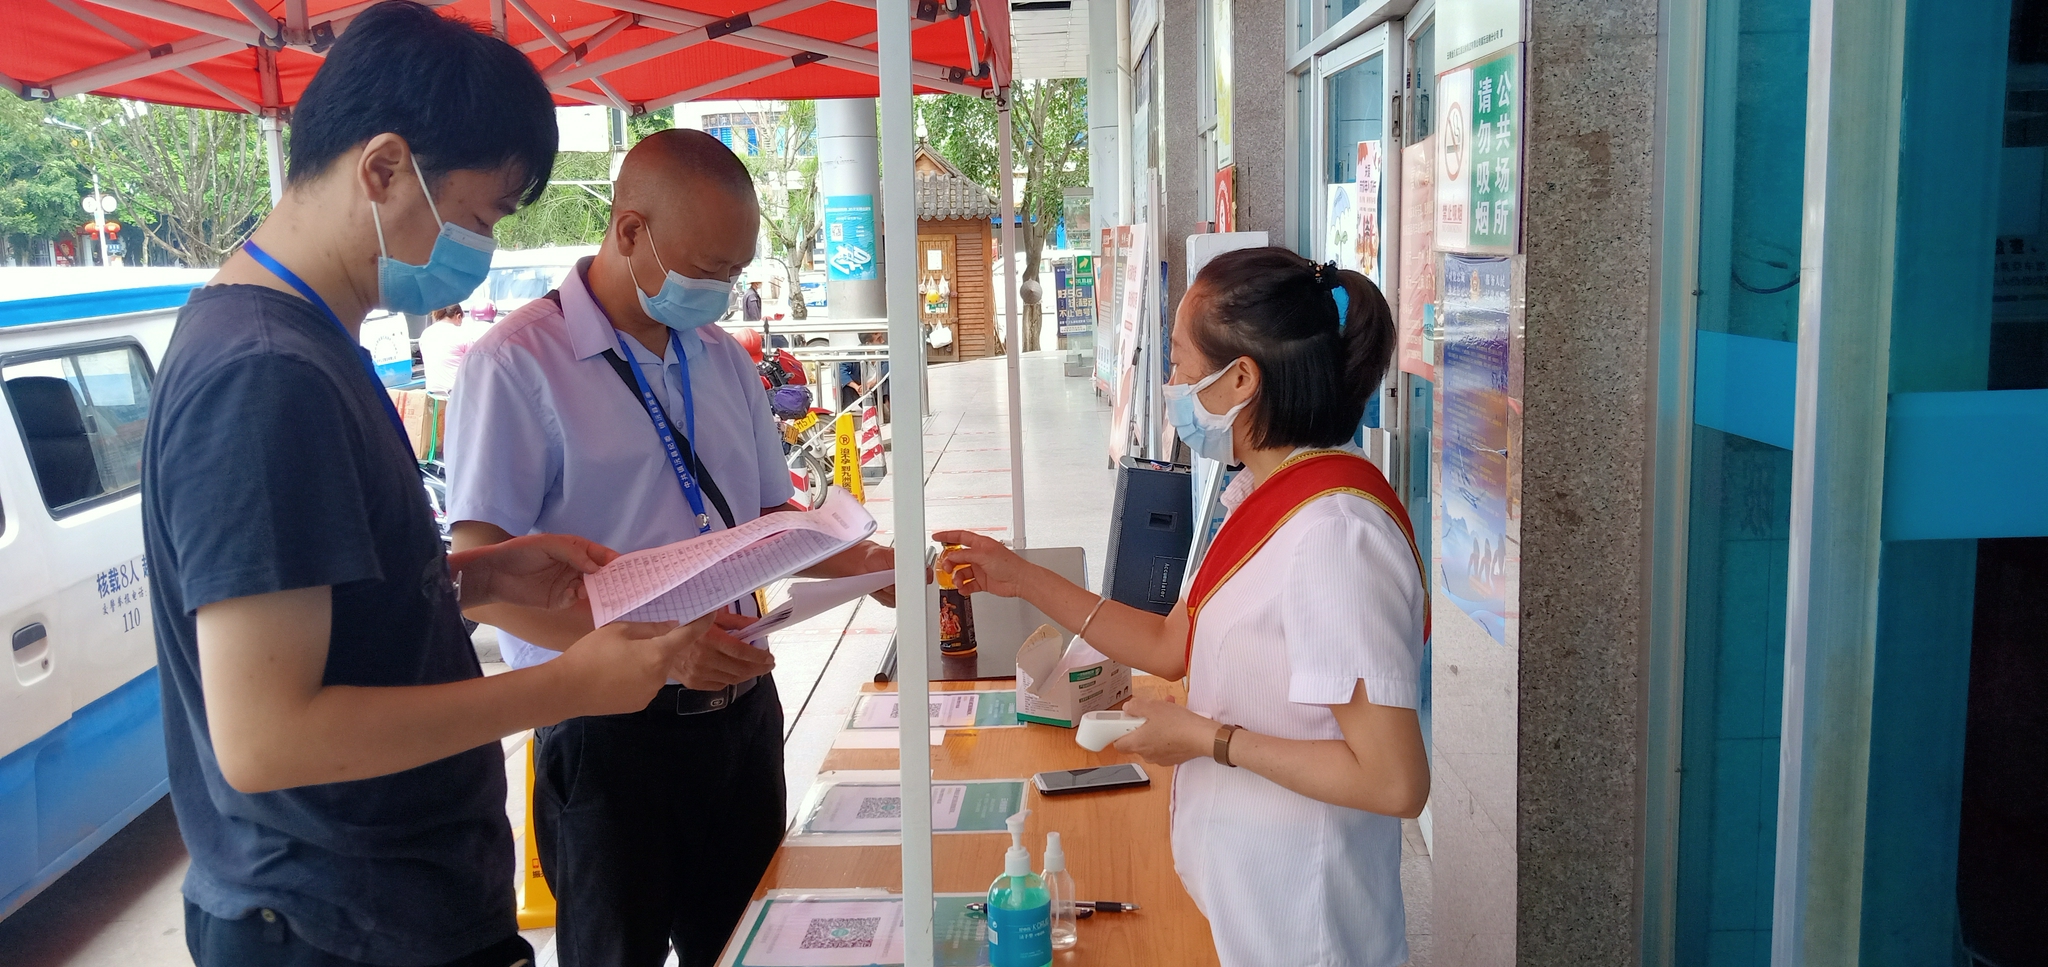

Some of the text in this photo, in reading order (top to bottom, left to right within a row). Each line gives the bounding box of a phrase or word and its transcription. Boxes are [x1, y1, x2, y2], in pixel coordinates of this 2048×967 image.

[1475, 77, 1493, 236] 请勿吸烟
[1492, 71, 1511, 236] 公共场所
[1442, 204, 1463, 221] 禁止吸烟
[96, 560, 140, 599] 核载8人
[122, 607, 141, 633] 110
